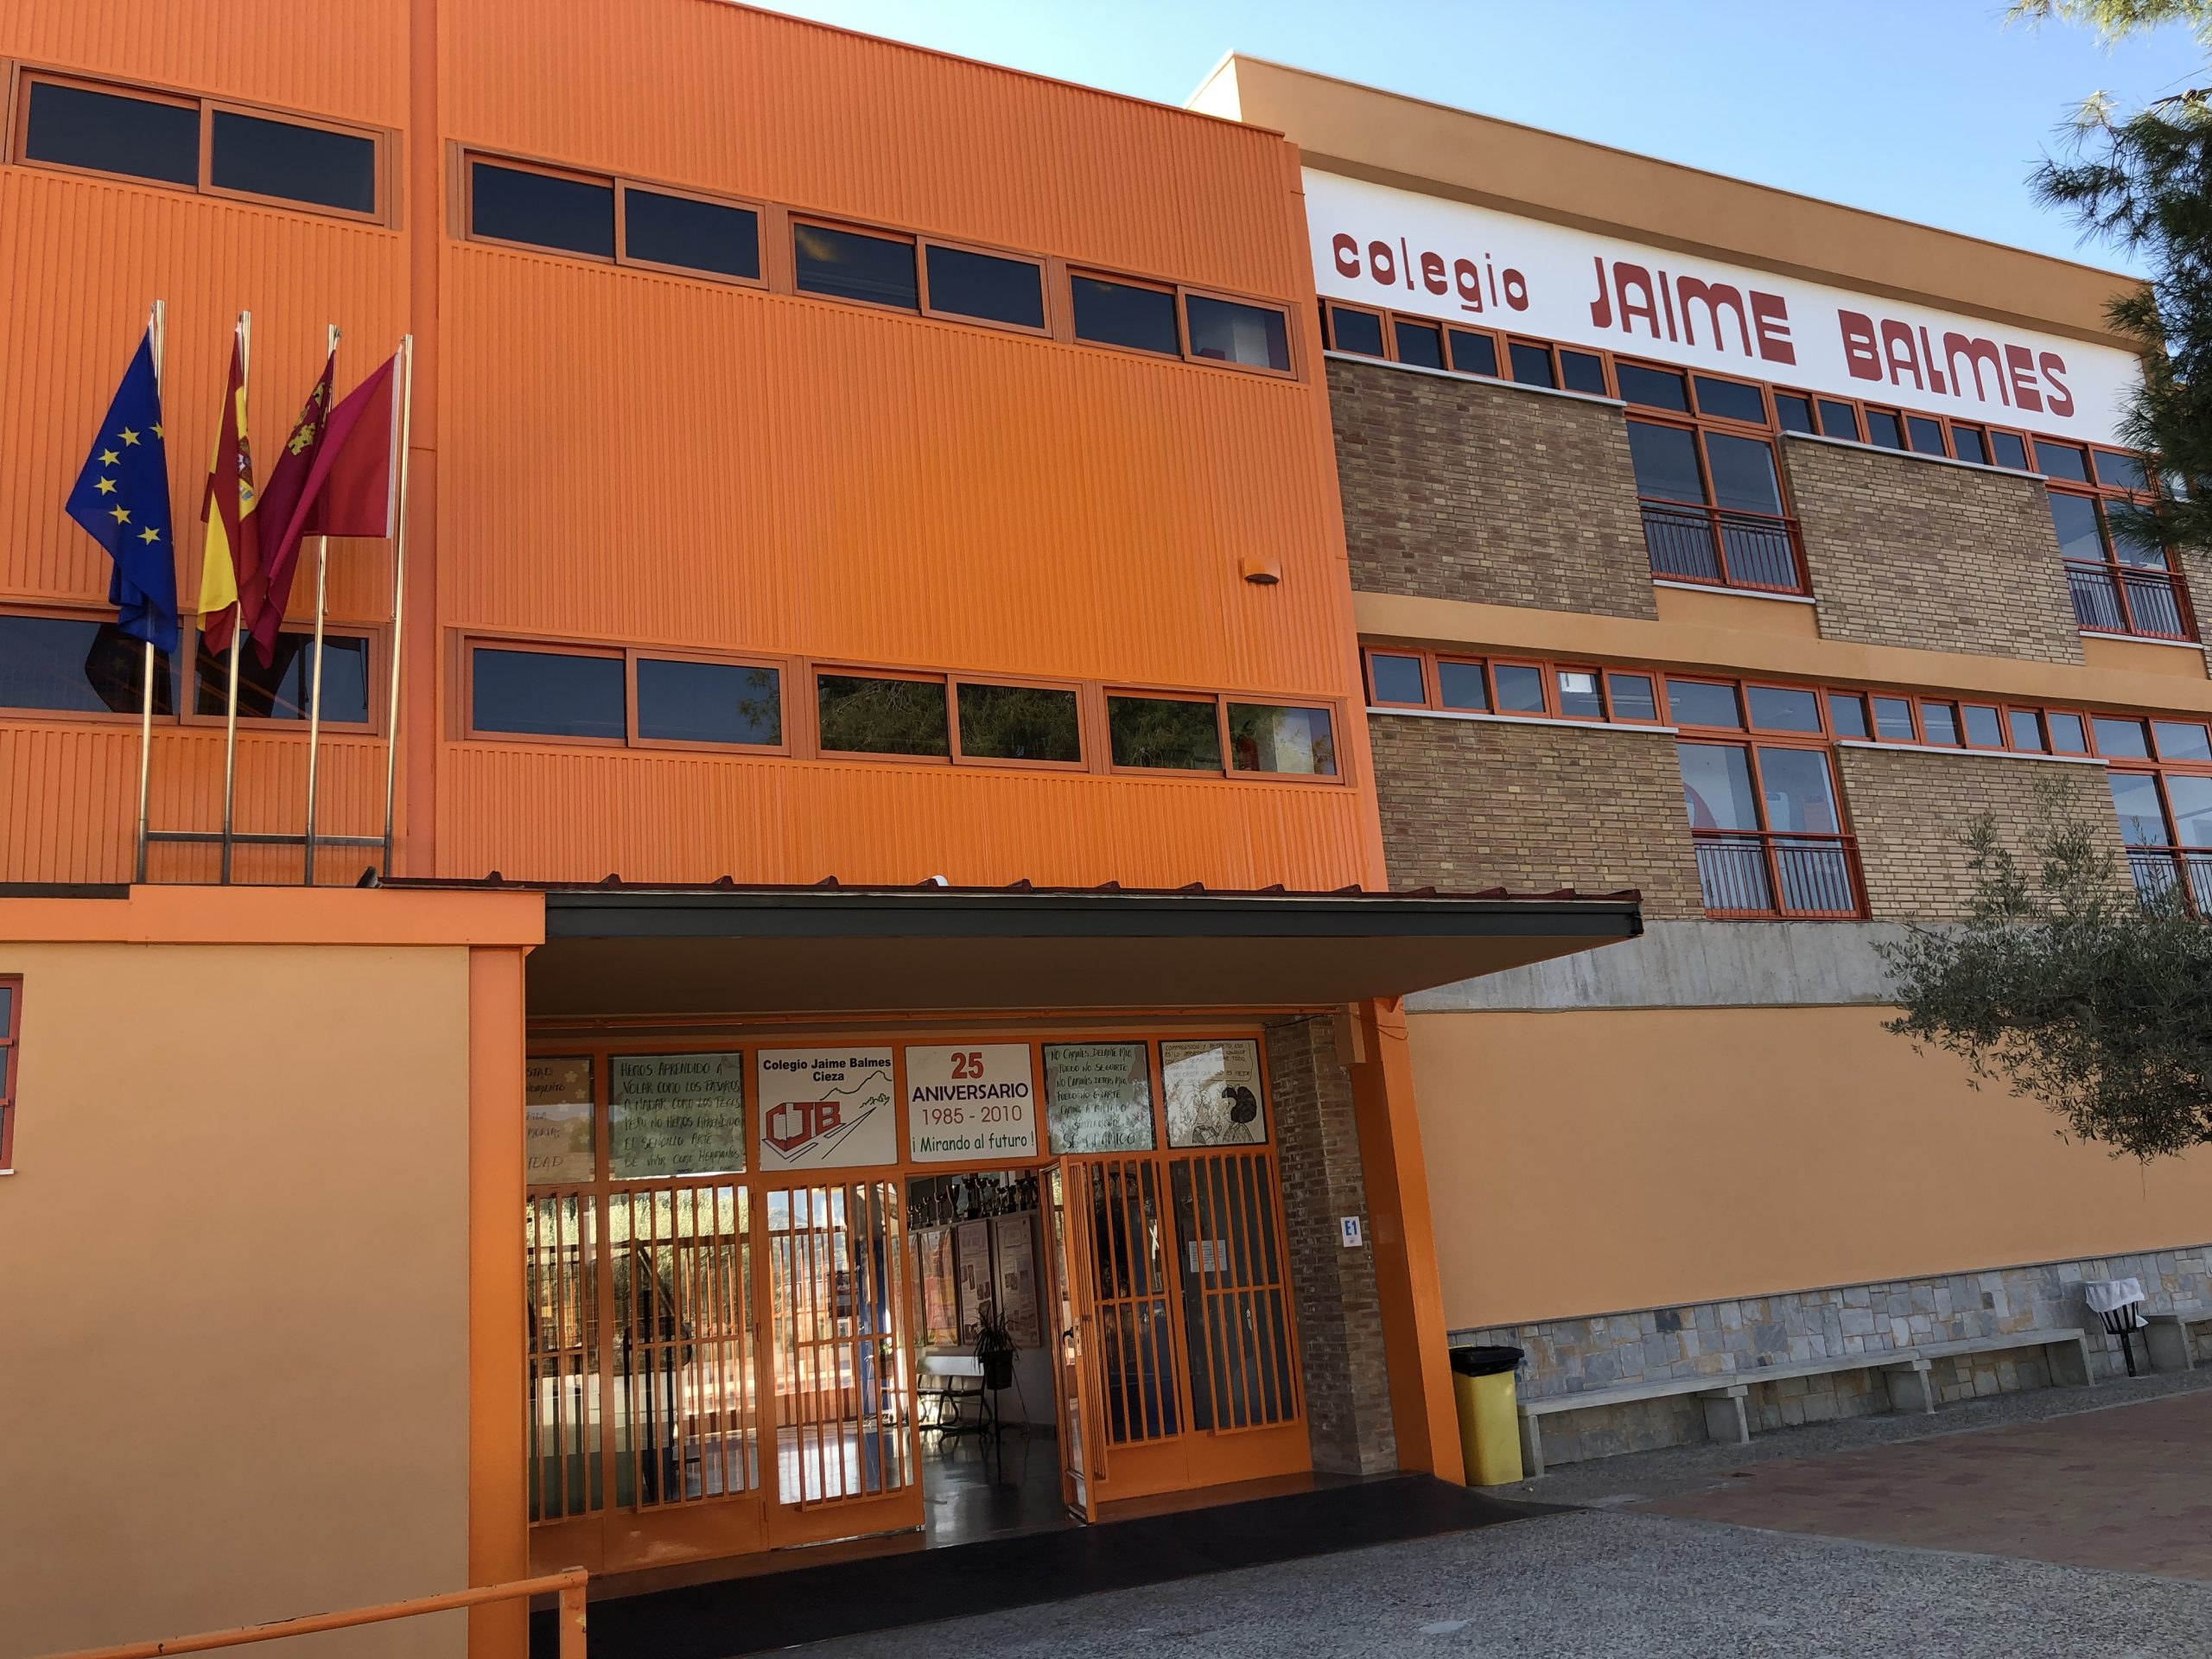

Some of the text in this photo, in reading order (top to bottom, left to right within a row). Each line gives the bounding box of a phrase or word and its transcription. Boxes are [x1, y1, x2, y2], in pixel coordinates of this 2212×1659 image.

[1332, 232, 2075, 418] colegio JAIME BALMES
[1051, 1048, 1061, 1061] NO
[658, 1061, 710, 1077] APRENDIDO
[763, 1057, 892, 1072] Colegio Jaime Balmes
[950, 1051, 984, 1079] 25
[1082, 1060, 1092, 1072] NO
[812, 1071, 845, 1082] Cieza
[1057, 1075, 1066, 1088] NO
[623, 1078, 653, 1095] VOLAR
[685, 1081, 702, 1093] LOS
[912, 1082, 1029, 1103] ANIVERSARIO
[923, 1107, 965, 1126] 1985
[979, 1104, 1022, 1123] 2010
[919, 1135, 971, 1154] Mirando
[973, 1132, 985, 1150] al
[988, 1129, 1027, 1149] futuro
[1344, 1219, 1358, 1236] E1
